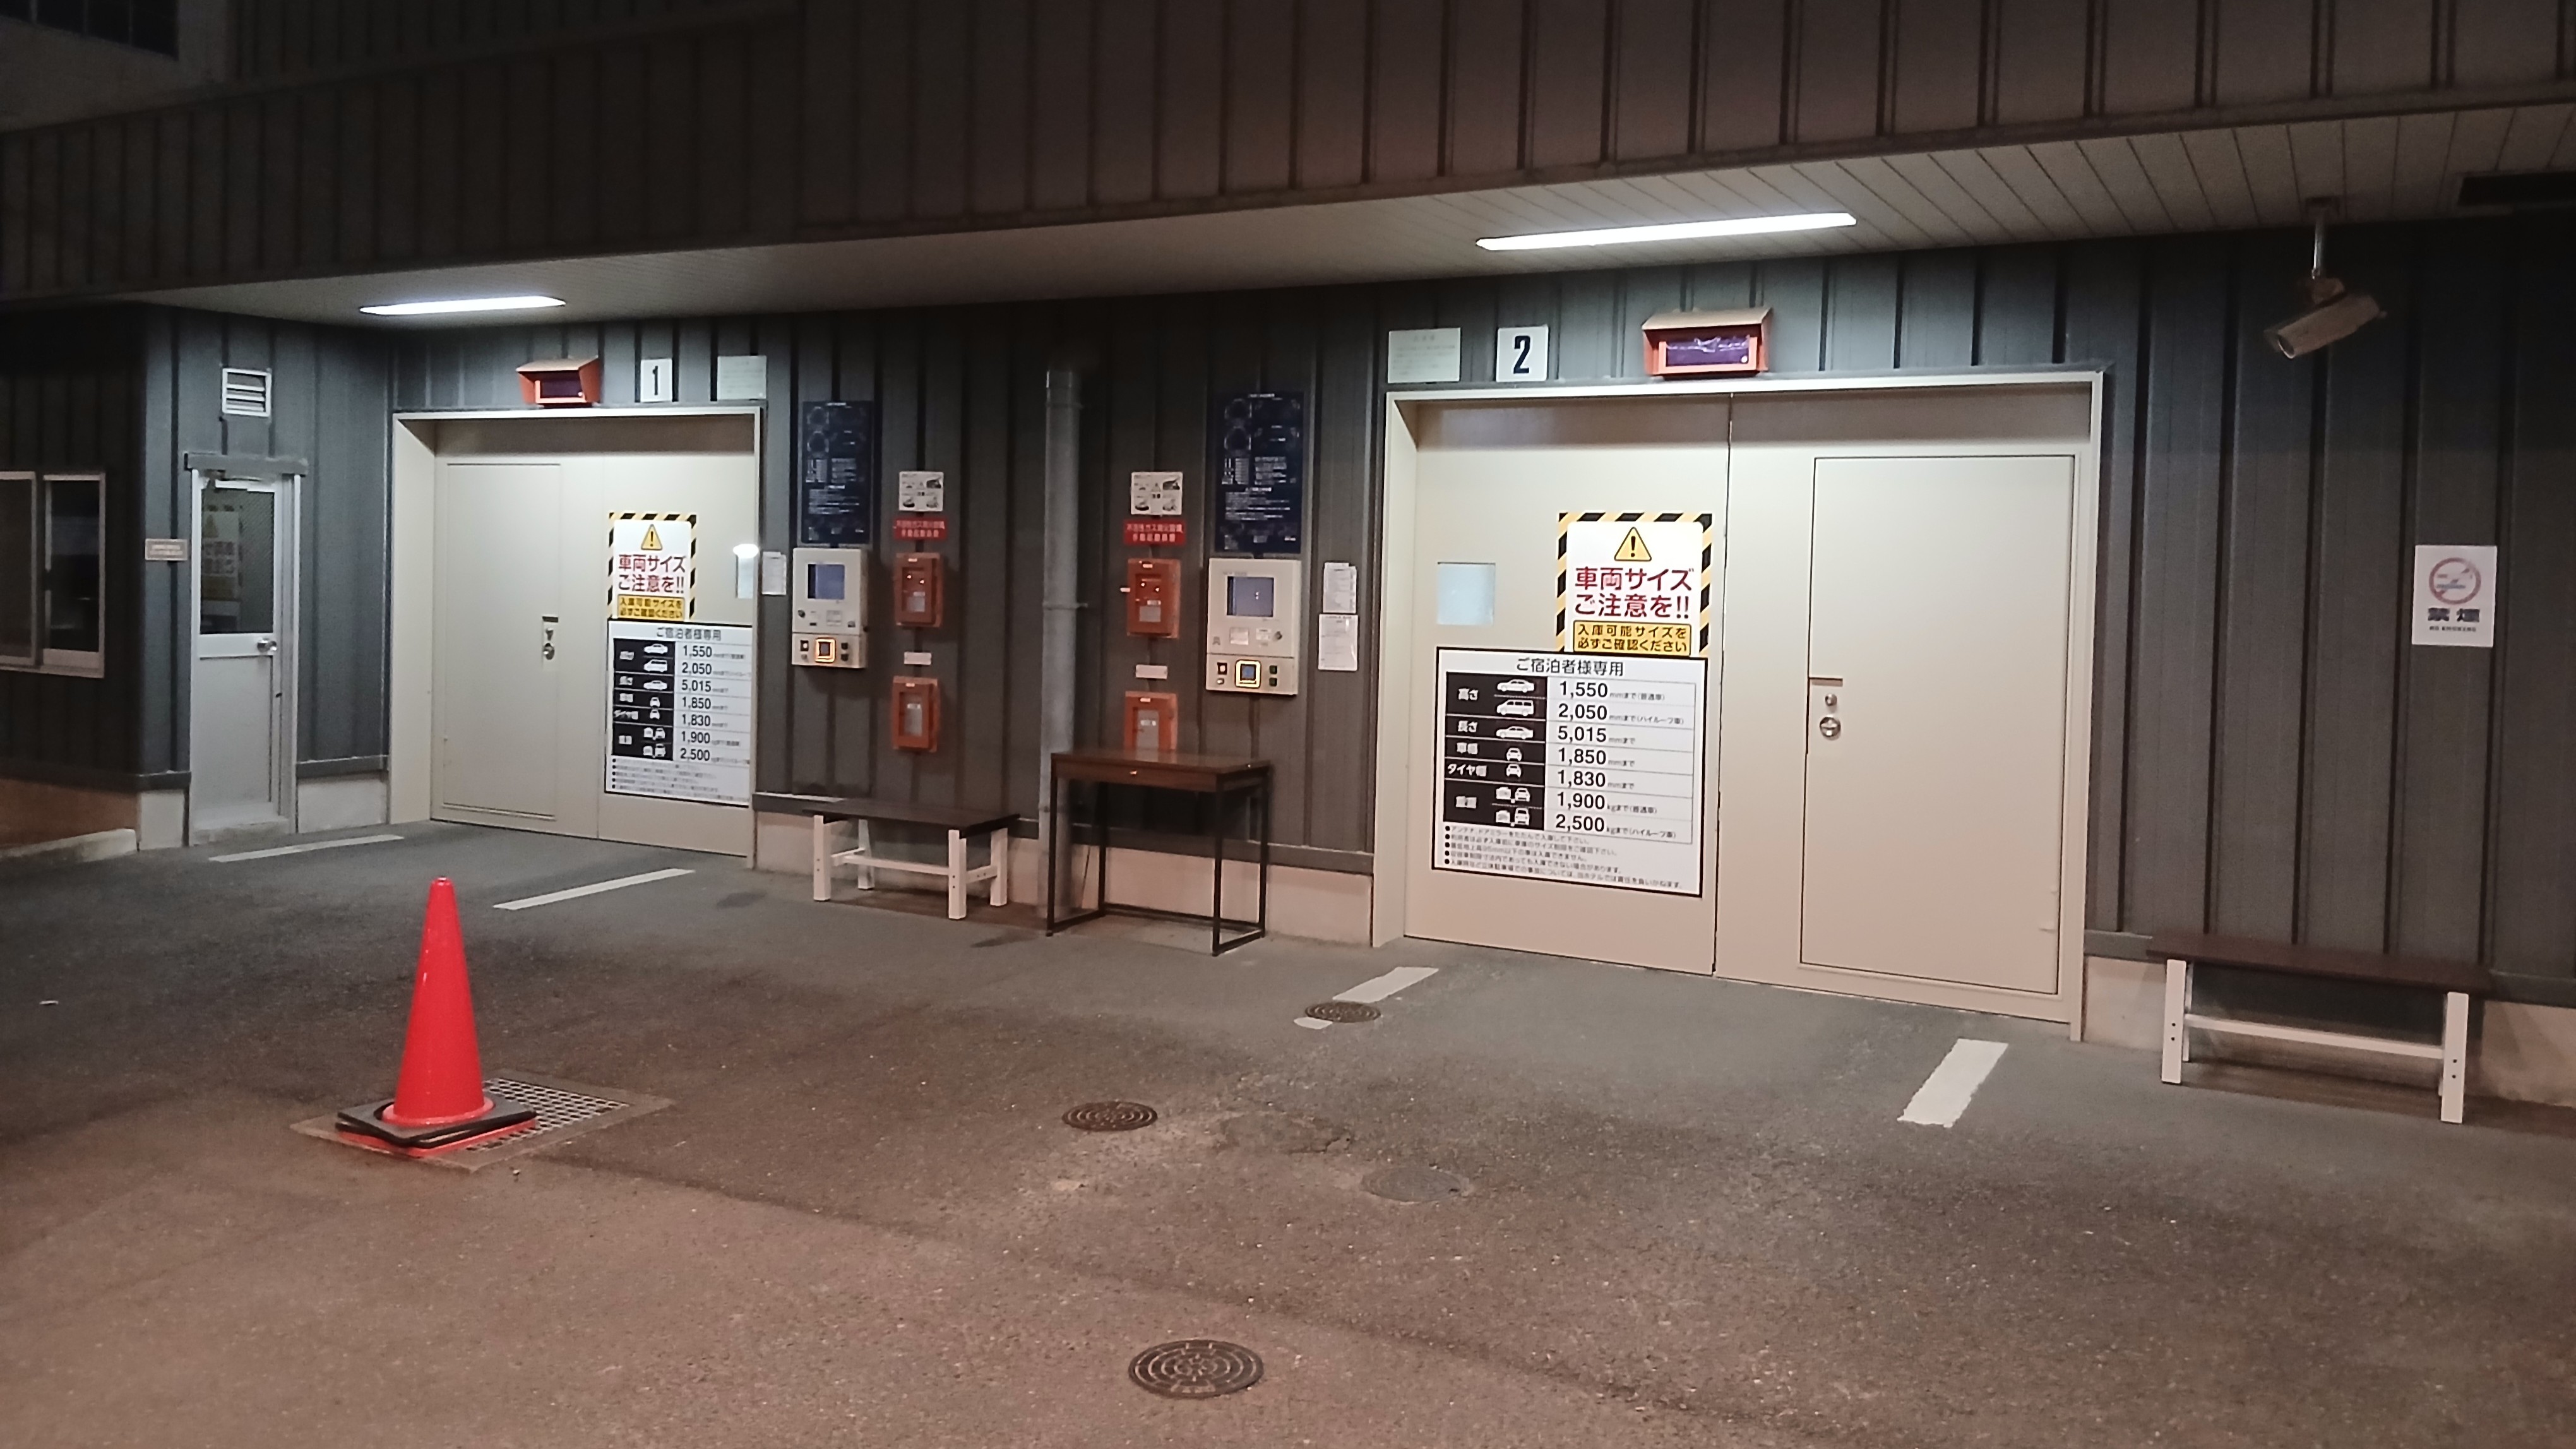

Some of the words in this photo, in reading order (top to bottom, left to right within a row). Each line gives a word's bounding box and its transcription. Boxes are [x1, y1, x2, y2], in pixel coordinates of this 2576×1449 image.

[1513, 335, 1530, 374] 2
[653, 366, 658, 395] 1
[619, 554, 686, 573] 車両サイズ
[1575, 566, 1695, 591] 車両サイズ
[1578, 624, 1686, 640] 入庫可能サイズを
[683, 645, 712, 659] 1,550
[1578, 637, 1687, 652] 必ずご確認ください
[681, 662, 712, 676] 2,050
[1517, 657, 1623, 677] ご宿泊者様専用
[681, 679, 712, 693] 5,015
[1559, 681, 1608, 698] 1,550
[682, 696, 712, 710] 1,850
[1558, 703, 1607, 721] 2,050
[682, 713, 711, 727] 1,830
[681, 730, 710, 744] 1,900
[1558, 725, 1606, 743] 5,015
[1558, 747, 1606, 766] 1,850
[1558, 769, 1606, 788] 1,830
[1557, 792, 1605, 810] 1,900
[1556, 814, 1604, 832] 2,500
